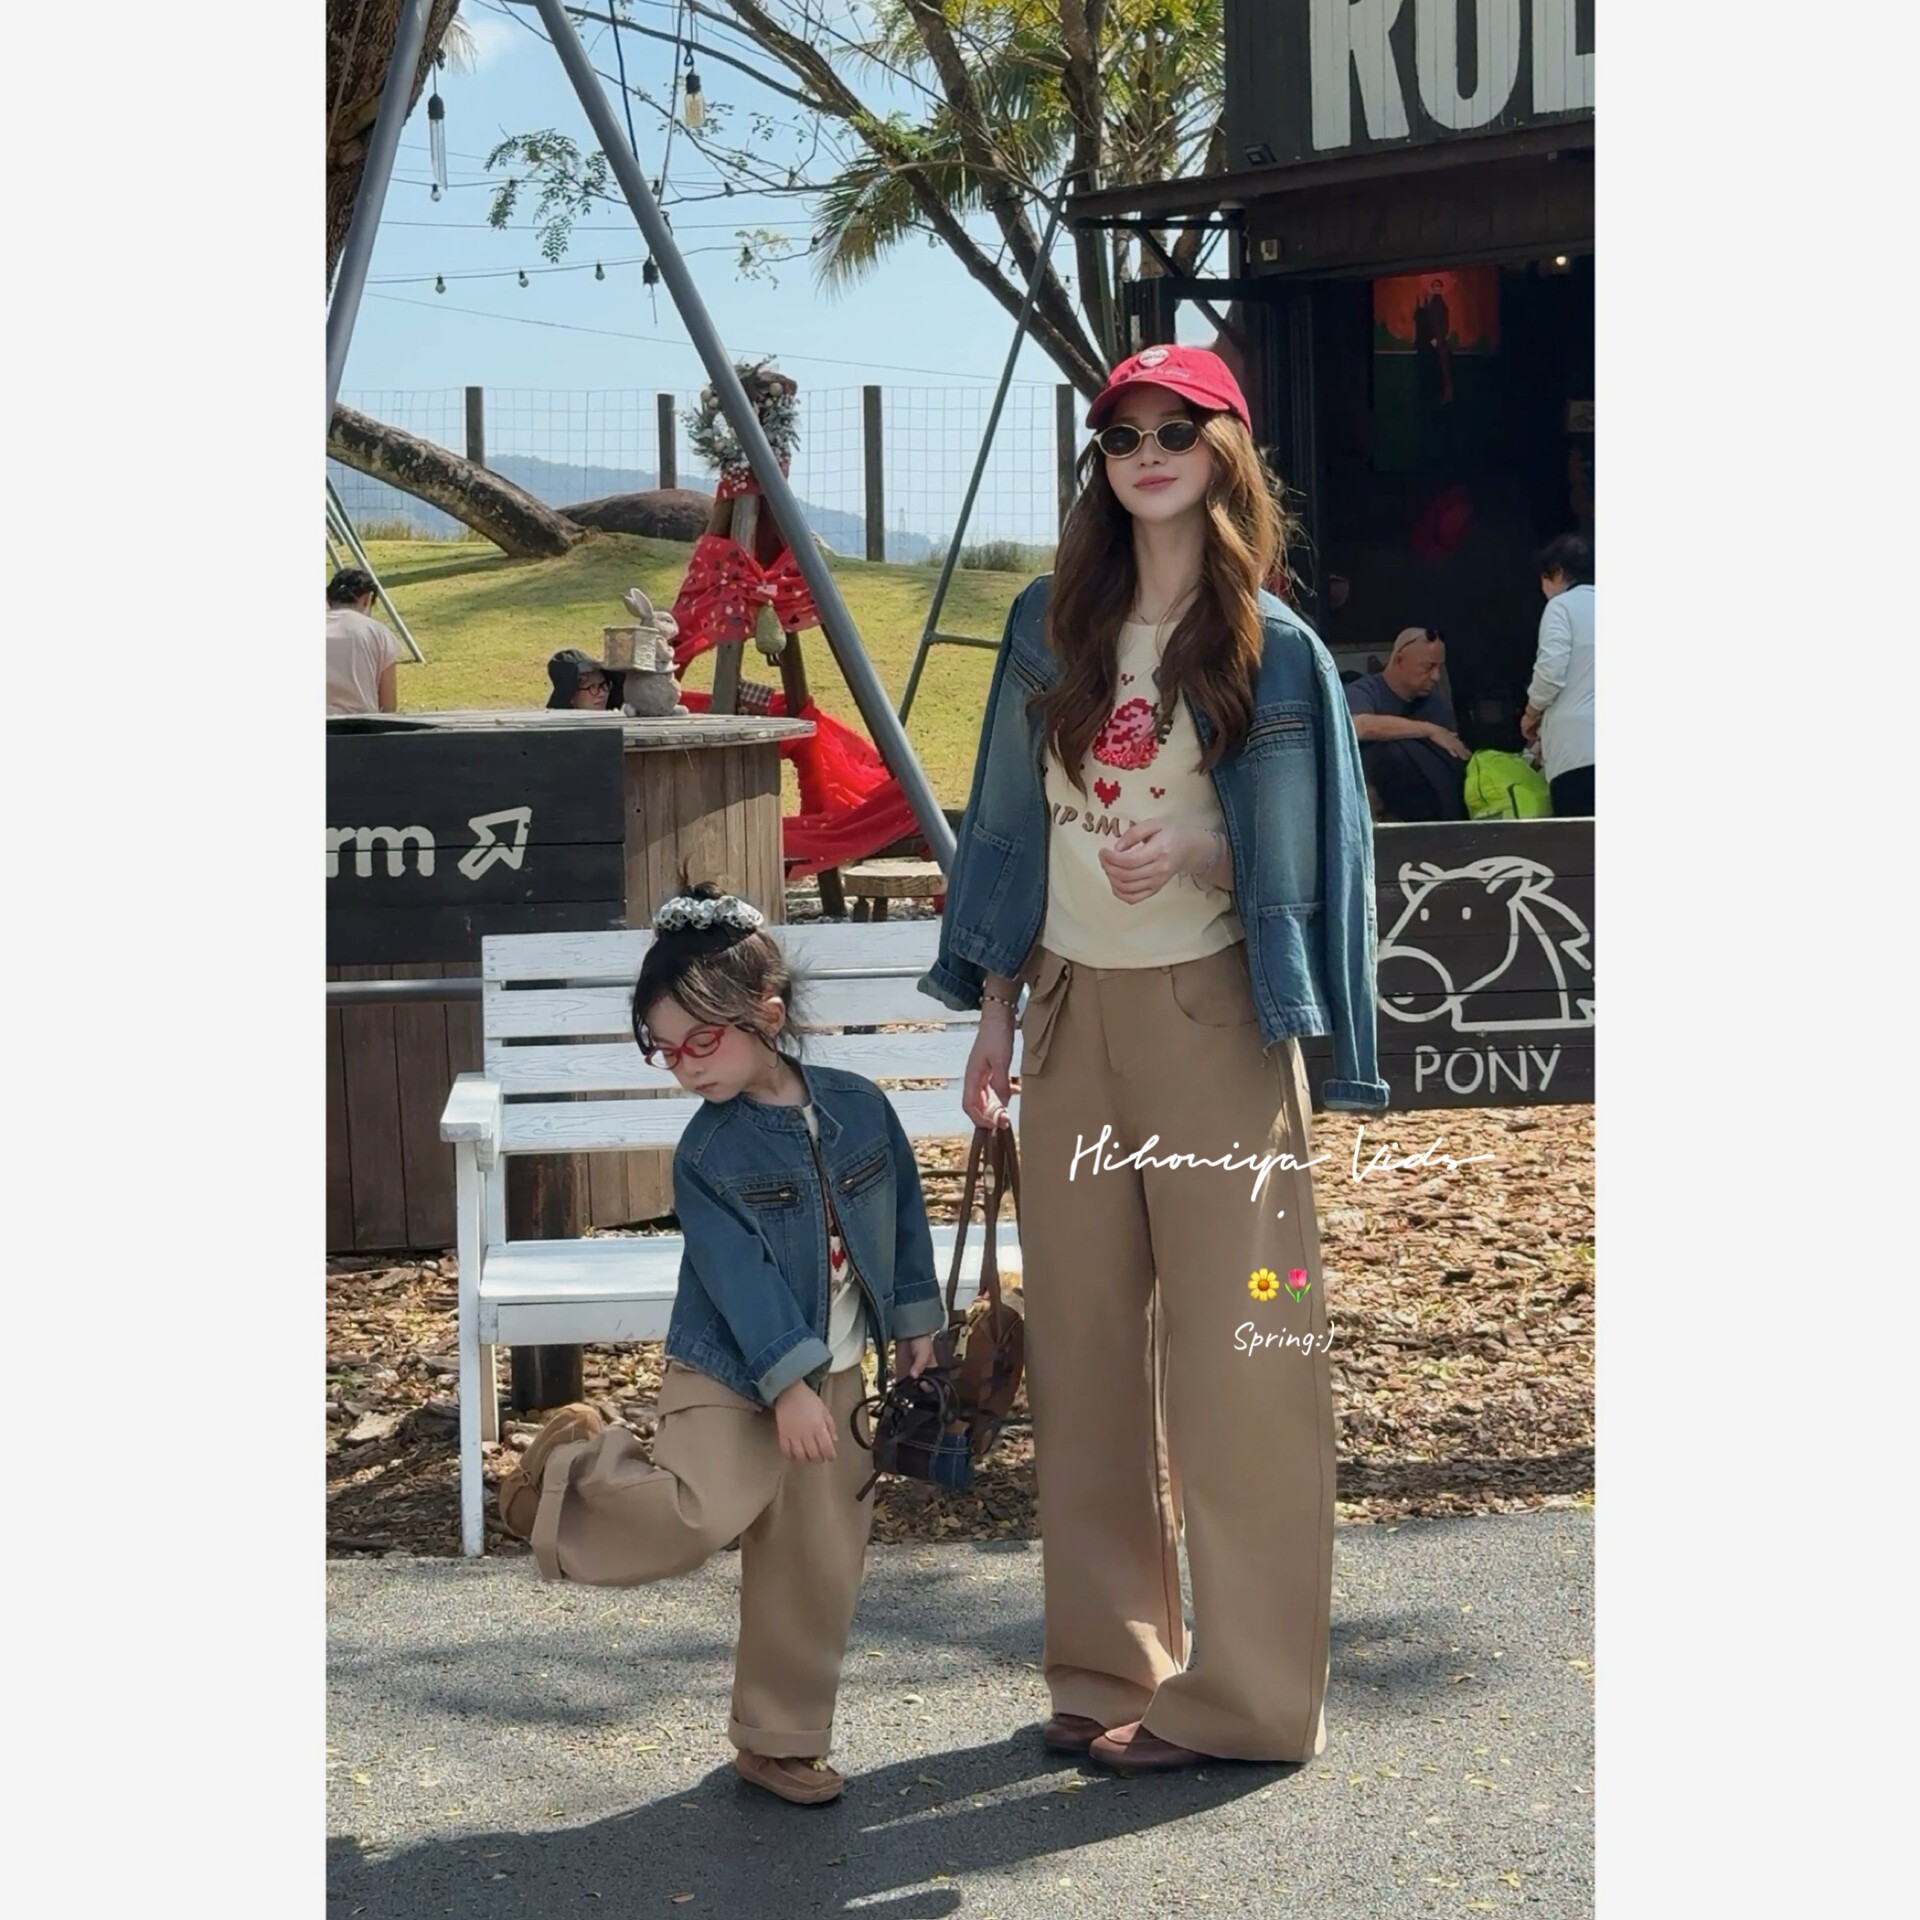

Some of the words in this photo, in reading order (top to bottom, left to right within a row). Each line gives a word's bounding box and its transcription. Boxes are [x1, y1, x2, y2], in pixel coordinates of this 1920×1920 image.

[1082, 812, 1136, 838] SM
[326, 825, 436, 878] rm
[1415, 1044, 1562, 1094] PONY
